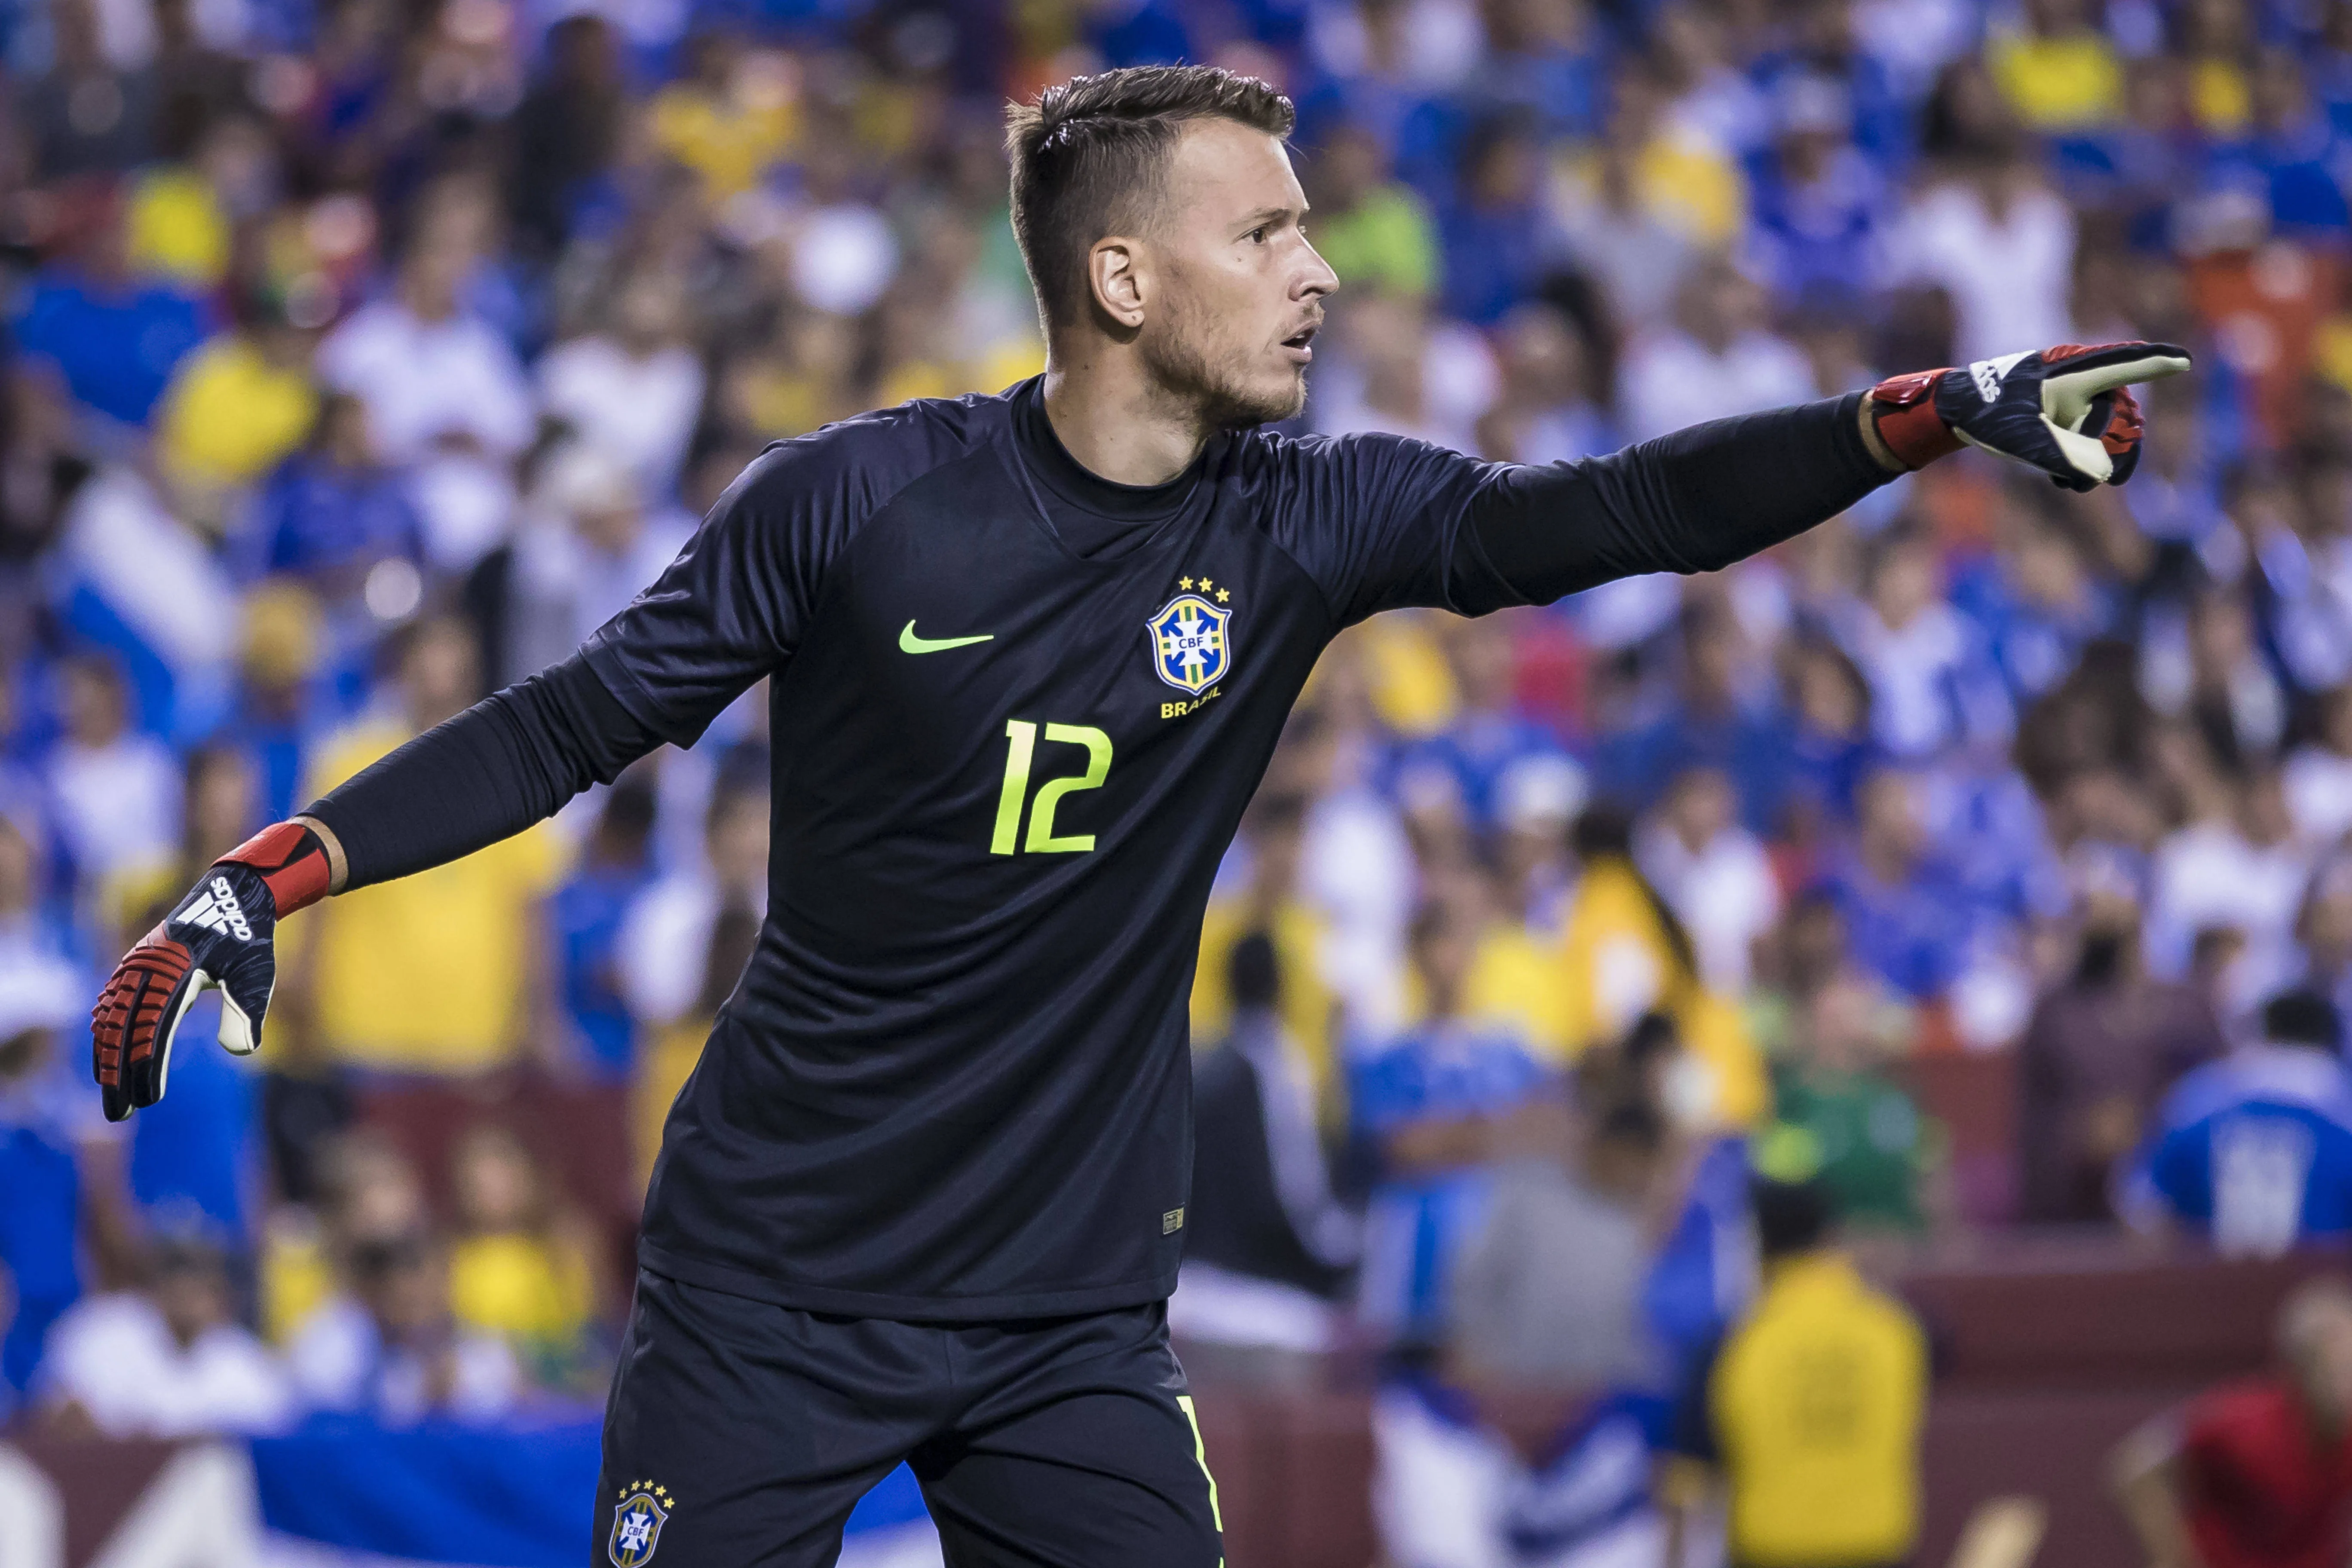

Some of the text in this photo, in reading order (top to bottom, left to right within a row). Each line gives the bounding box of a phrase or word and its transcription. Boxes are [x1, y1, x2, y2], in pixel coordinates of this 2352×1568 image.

[1179, 637, 1204, 649] CBF
[1161, 686, 1221, 719] BRASIL
[990, 719, 1113, 856] 12
[210, 876, 252, 941] adidas
[627, 1526, 644, 1536] CBF
